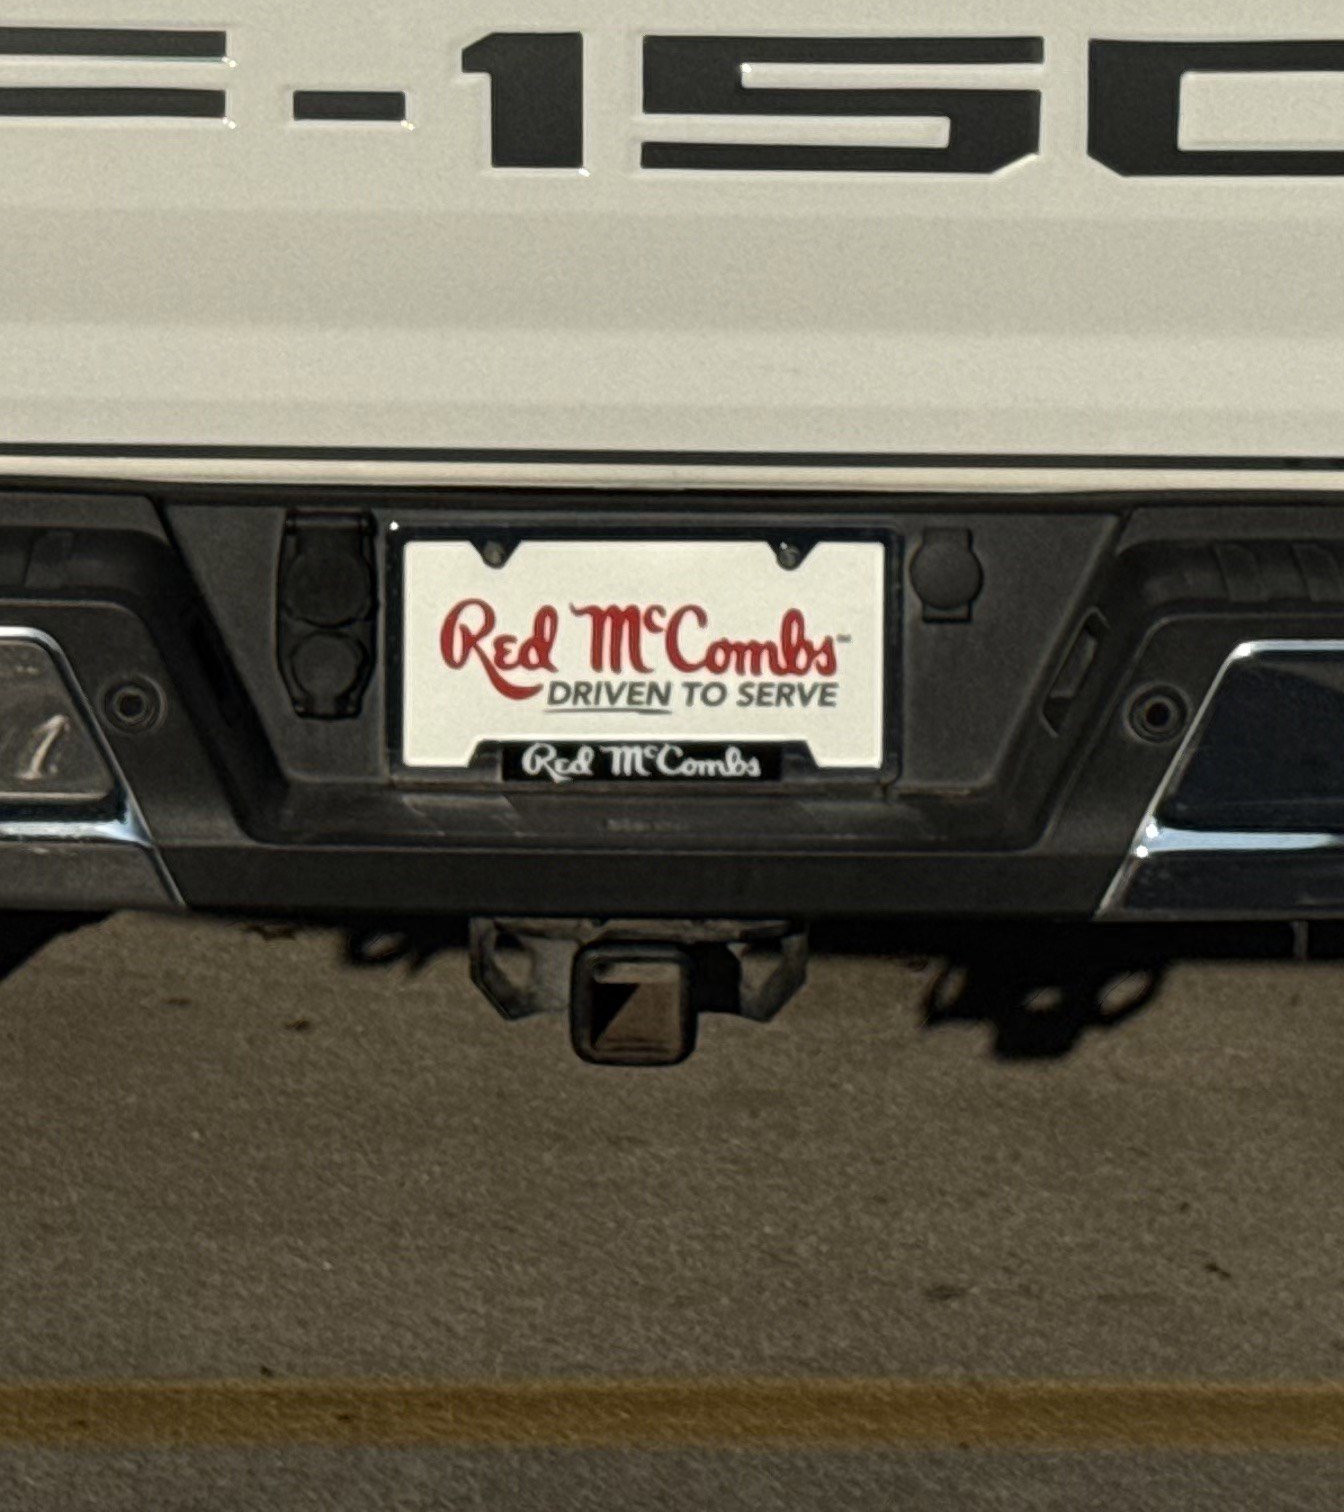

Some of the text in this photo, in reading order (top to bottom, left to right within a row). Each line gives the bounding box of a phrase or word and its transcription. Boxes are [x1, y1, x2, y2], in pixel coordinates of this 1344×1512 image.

[440, 598, 837, 700] Red McCombs
[546, 681, 839, 708] DRIVEN TO SERVE
[522, 742, 762, 782] Red McCombs
